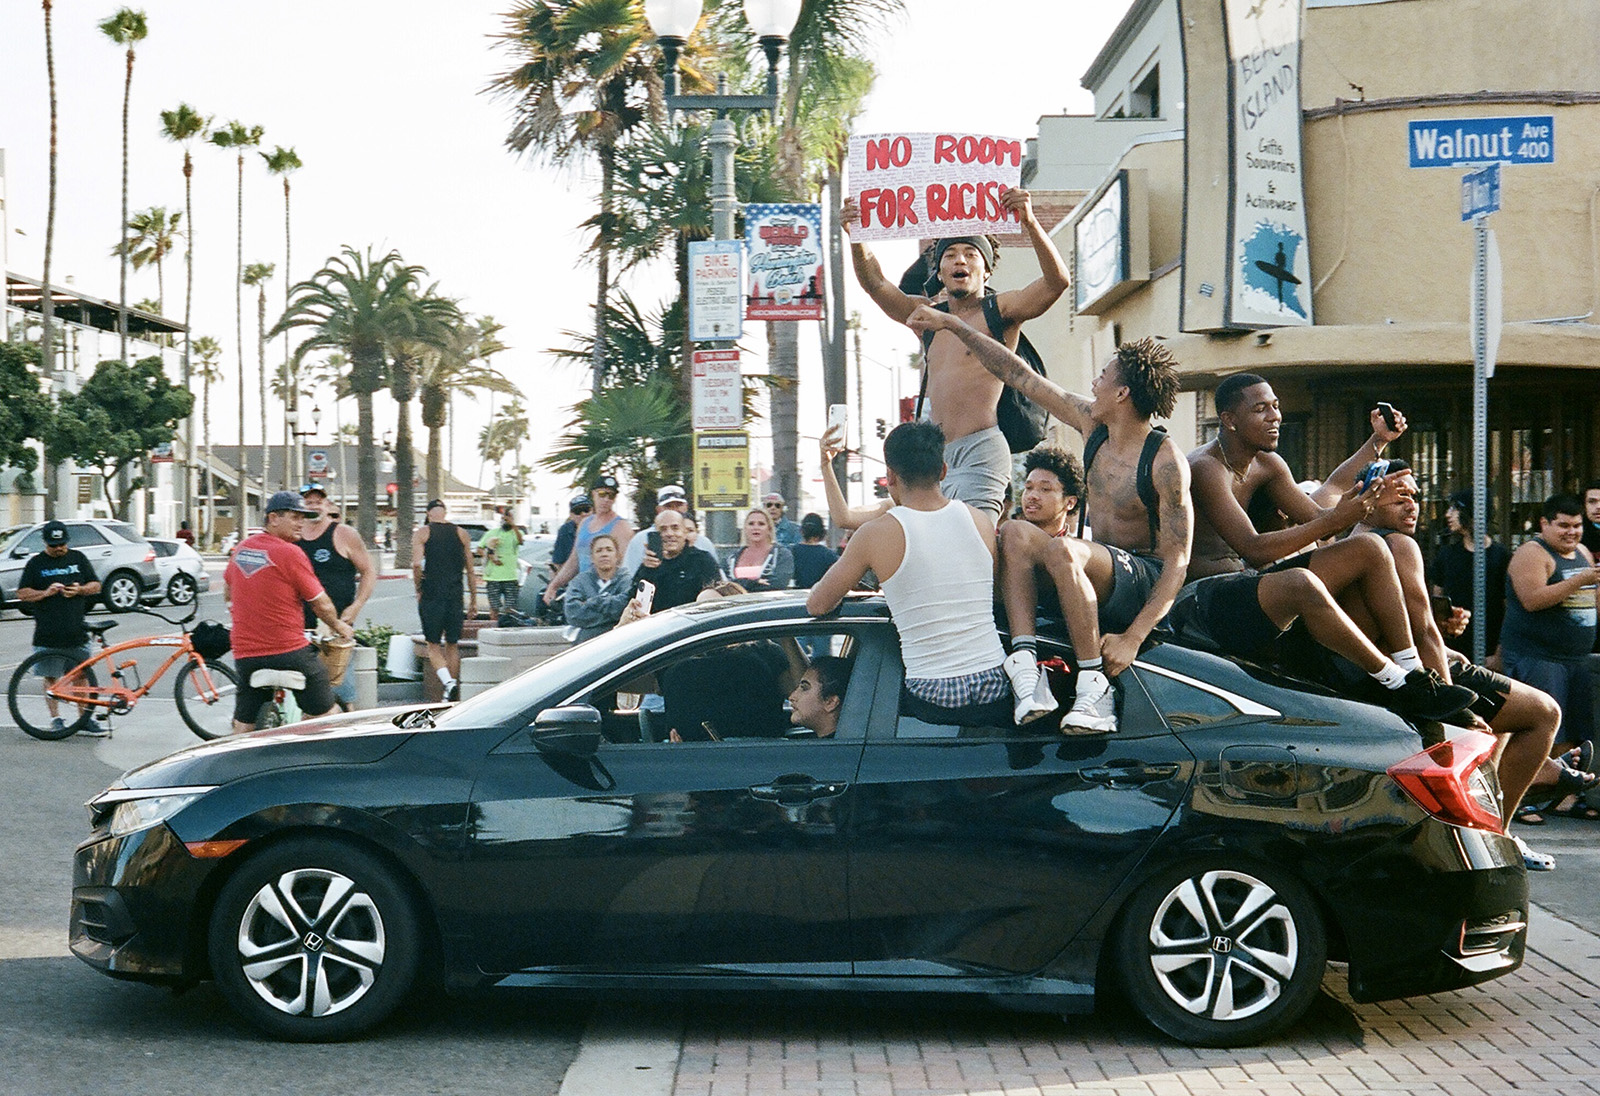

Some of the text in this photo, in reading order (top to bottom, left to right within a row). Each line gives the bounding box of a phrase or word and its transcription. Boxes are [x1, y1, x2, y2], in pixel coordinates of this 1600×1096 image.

[1241, 64, 1293, 131] ISLAND
[1258, 137, 1283, 155] Gifts
[1414, 123, 1549, 160] Walnut Ave
[1517, 142, 1550, 158] 400
[866, 136, 912, 171] NO
[934, 134, 1021, 168] ROOM
[1245, 152, 1296, 173] Souvenirs
[1268, 180, 1276, 194] &
[860, 185, 918, 228] FOR
[1245, 193, 1297, 212] Activewear
[759, 225, 808, 239] WORLD
[704, 255, 729, 267] BIKE
[695, 267, 738, 279] PARKING
[708, 362, 738, 373] PARKING
